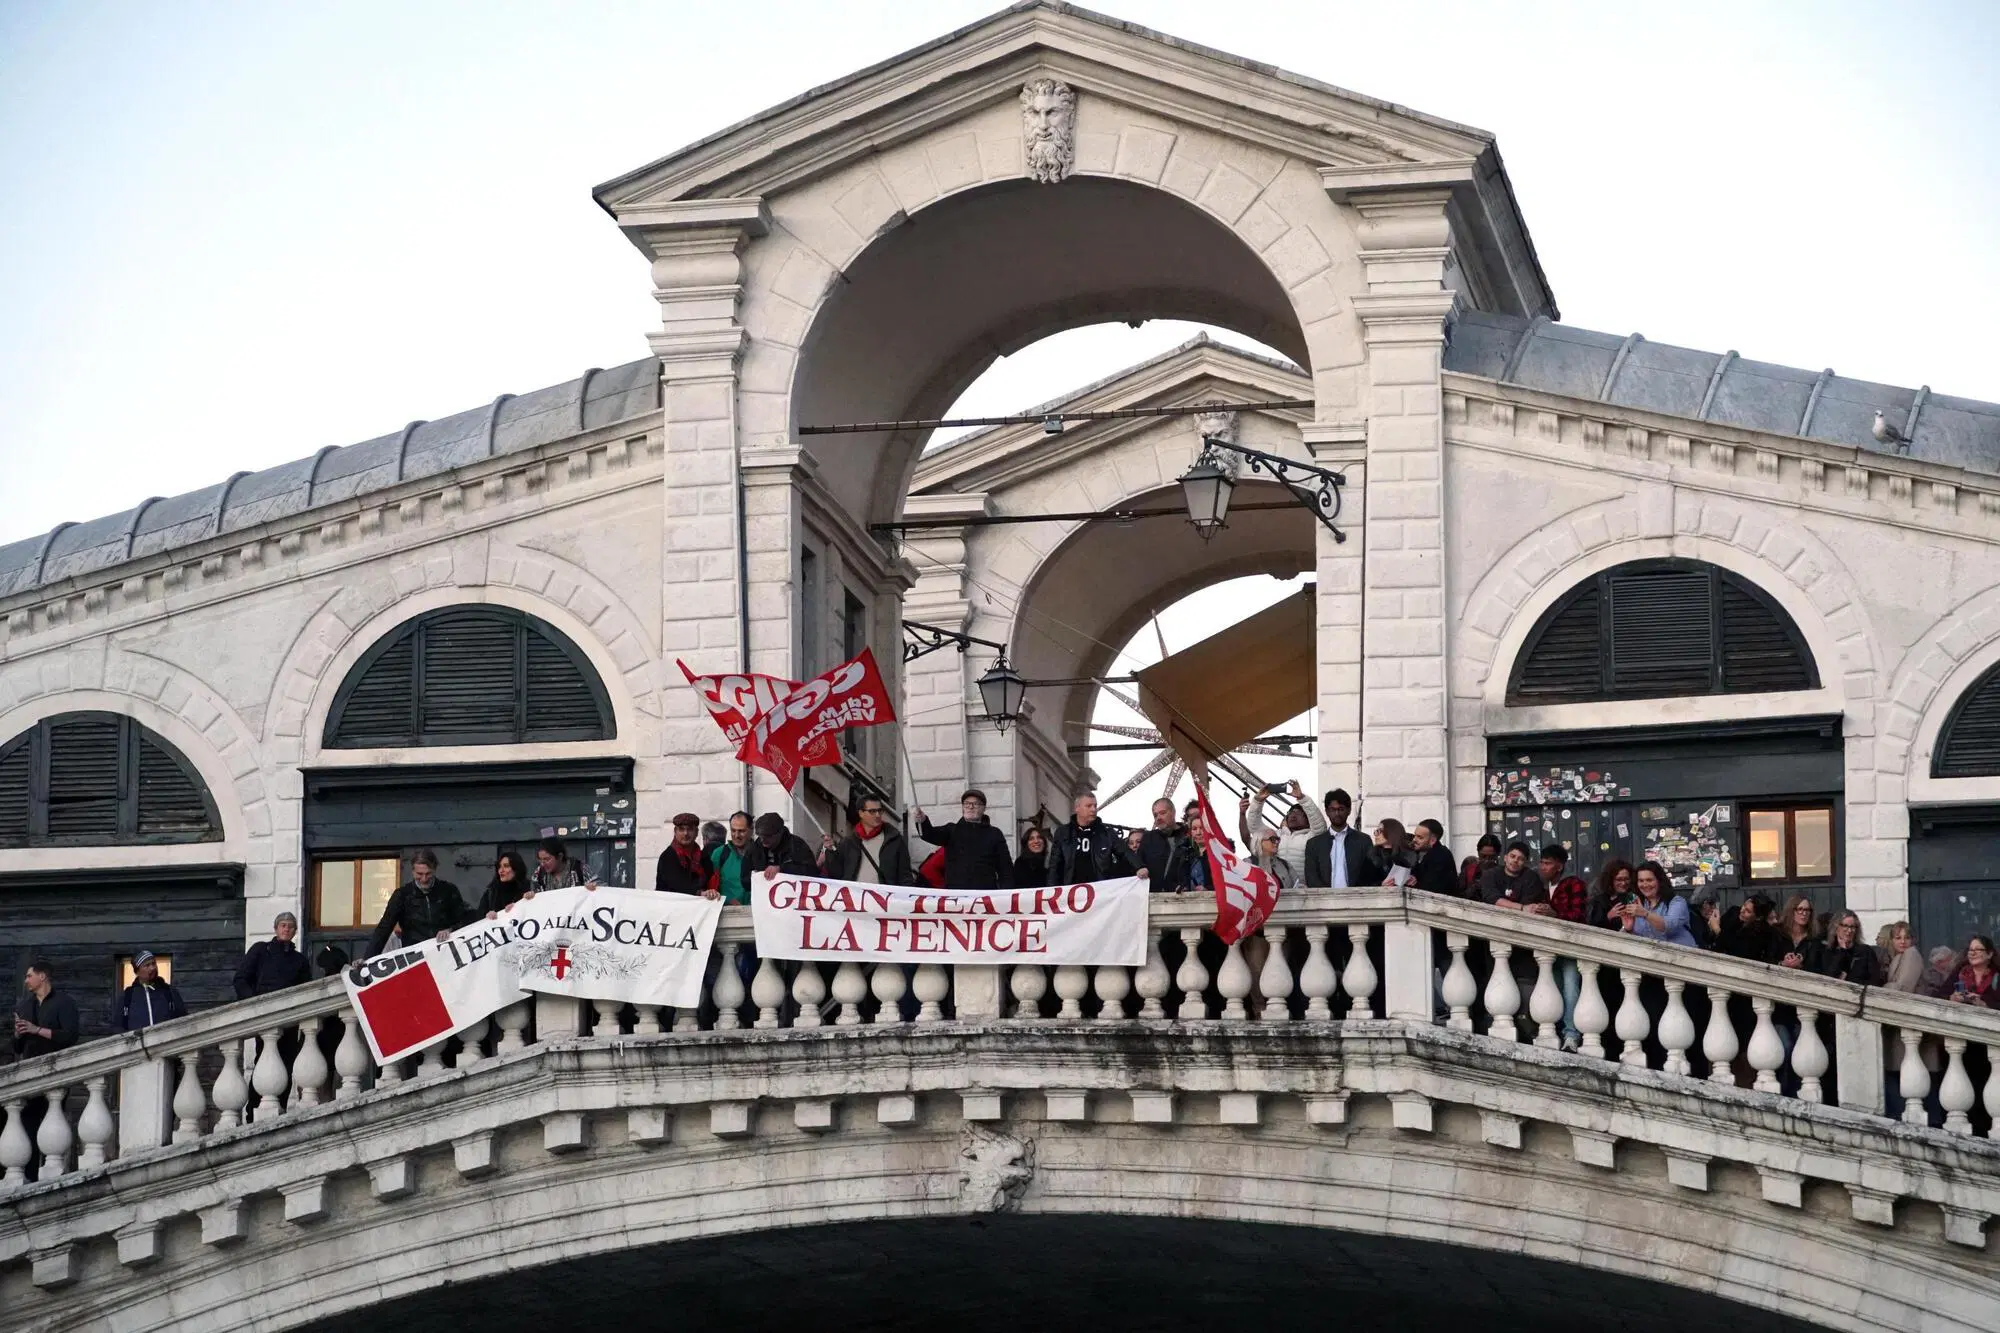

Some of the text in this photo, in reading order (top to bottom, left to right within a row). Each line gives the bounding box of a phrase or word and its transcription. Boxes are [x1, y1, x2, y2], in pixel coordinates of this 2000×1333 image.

[768, 879, 1095, 915] GRAN TEATRO
[543, 916, 589, 931] ALLA
[591, 906, 699, 950] SCALA
[799, 915, 1048, 953] LA FENICE
[349, 950, 425, 988] CGIL
